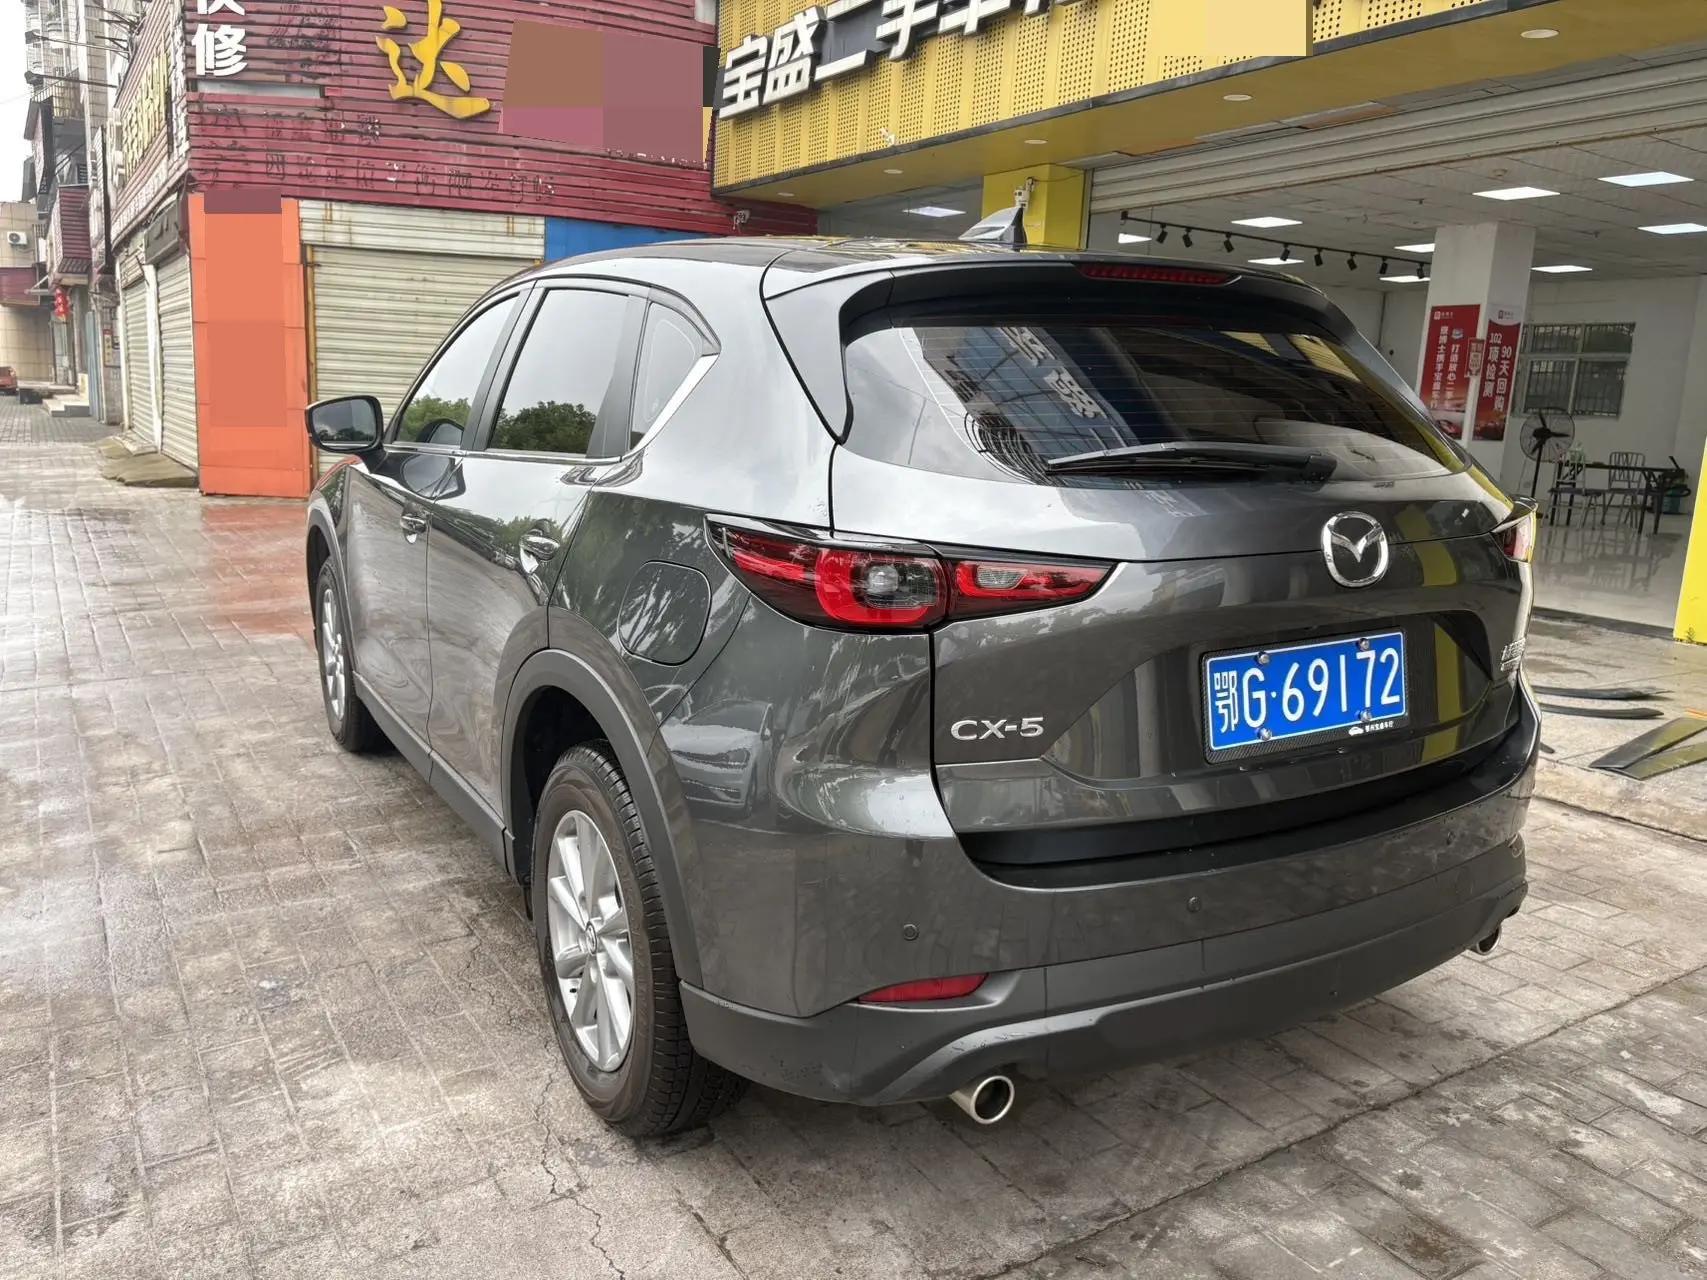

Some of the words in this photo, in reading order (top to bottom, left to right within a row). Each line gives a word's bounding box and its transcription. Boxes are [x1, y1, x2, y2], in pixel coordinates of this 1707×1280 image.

[191, 0, 248, 76] 修
[719, 0, 1041, 120] 宝盛二手
[950, 716, 1044, 741] CX-5
